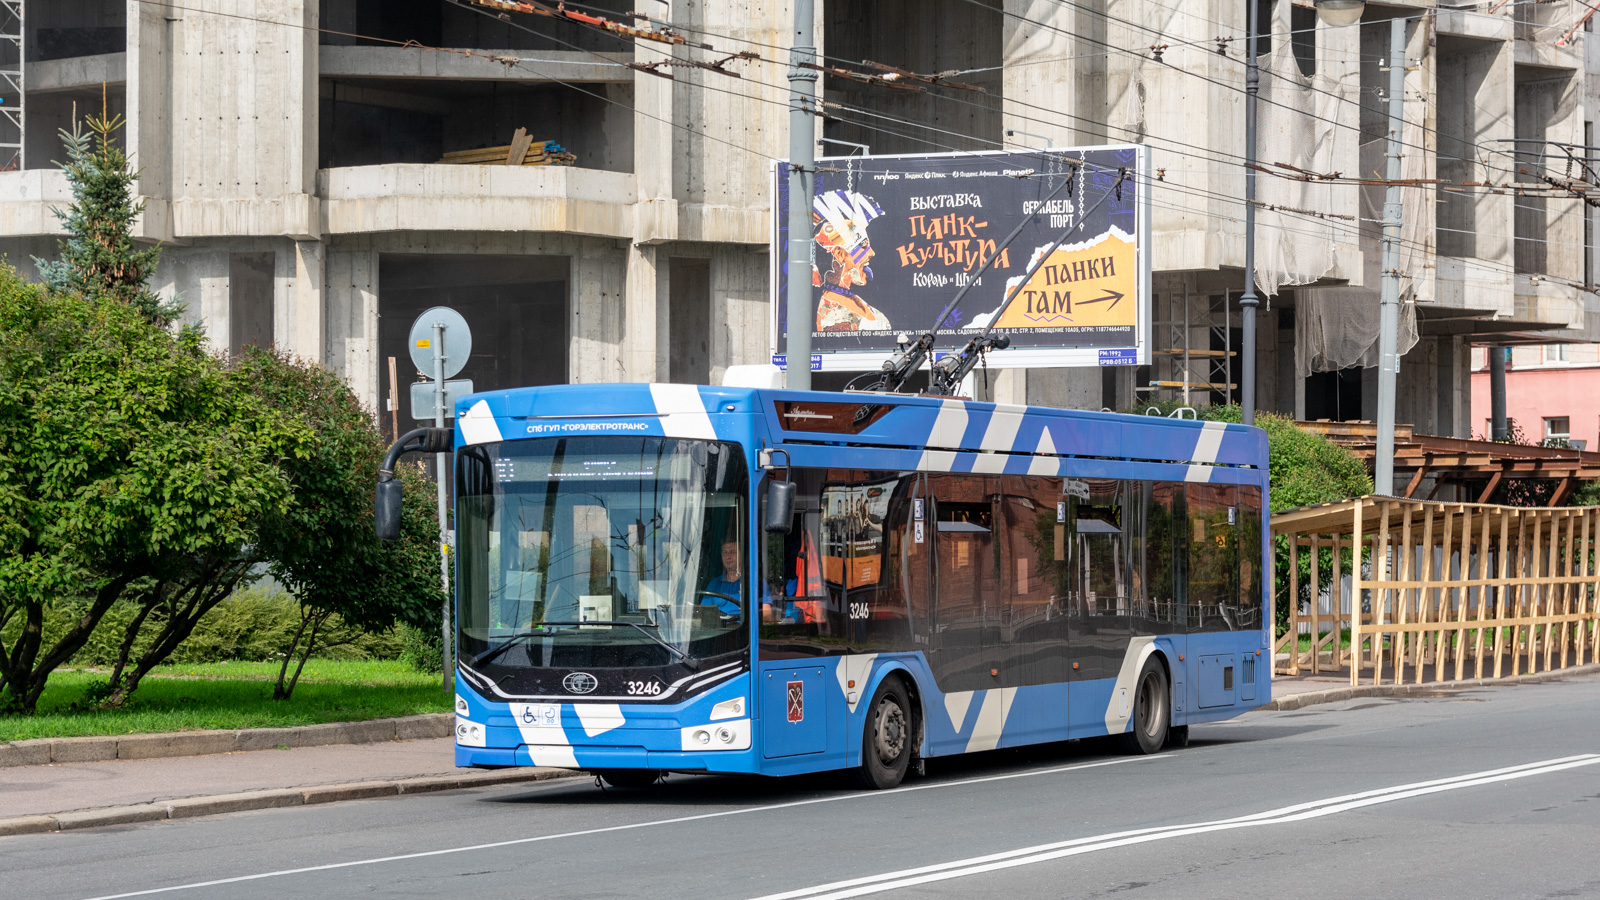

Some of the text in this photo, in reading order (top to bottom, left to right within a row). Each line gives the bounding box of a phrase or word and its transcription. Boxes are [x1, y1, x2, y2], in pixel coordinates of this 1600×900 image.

[1050, 214, 1074, 228] ПОРТ
[1045, 256, 1116, 286] ПАНКИ
[1023, 290, 1072, 314] ТАМ
[526, 423, 649, 433] СПб ГУП «ГОРЭЛЕКТРОТРАНС»
[849, 602, 869, 620] 3246
[627, 680, 660, 695] 3246
